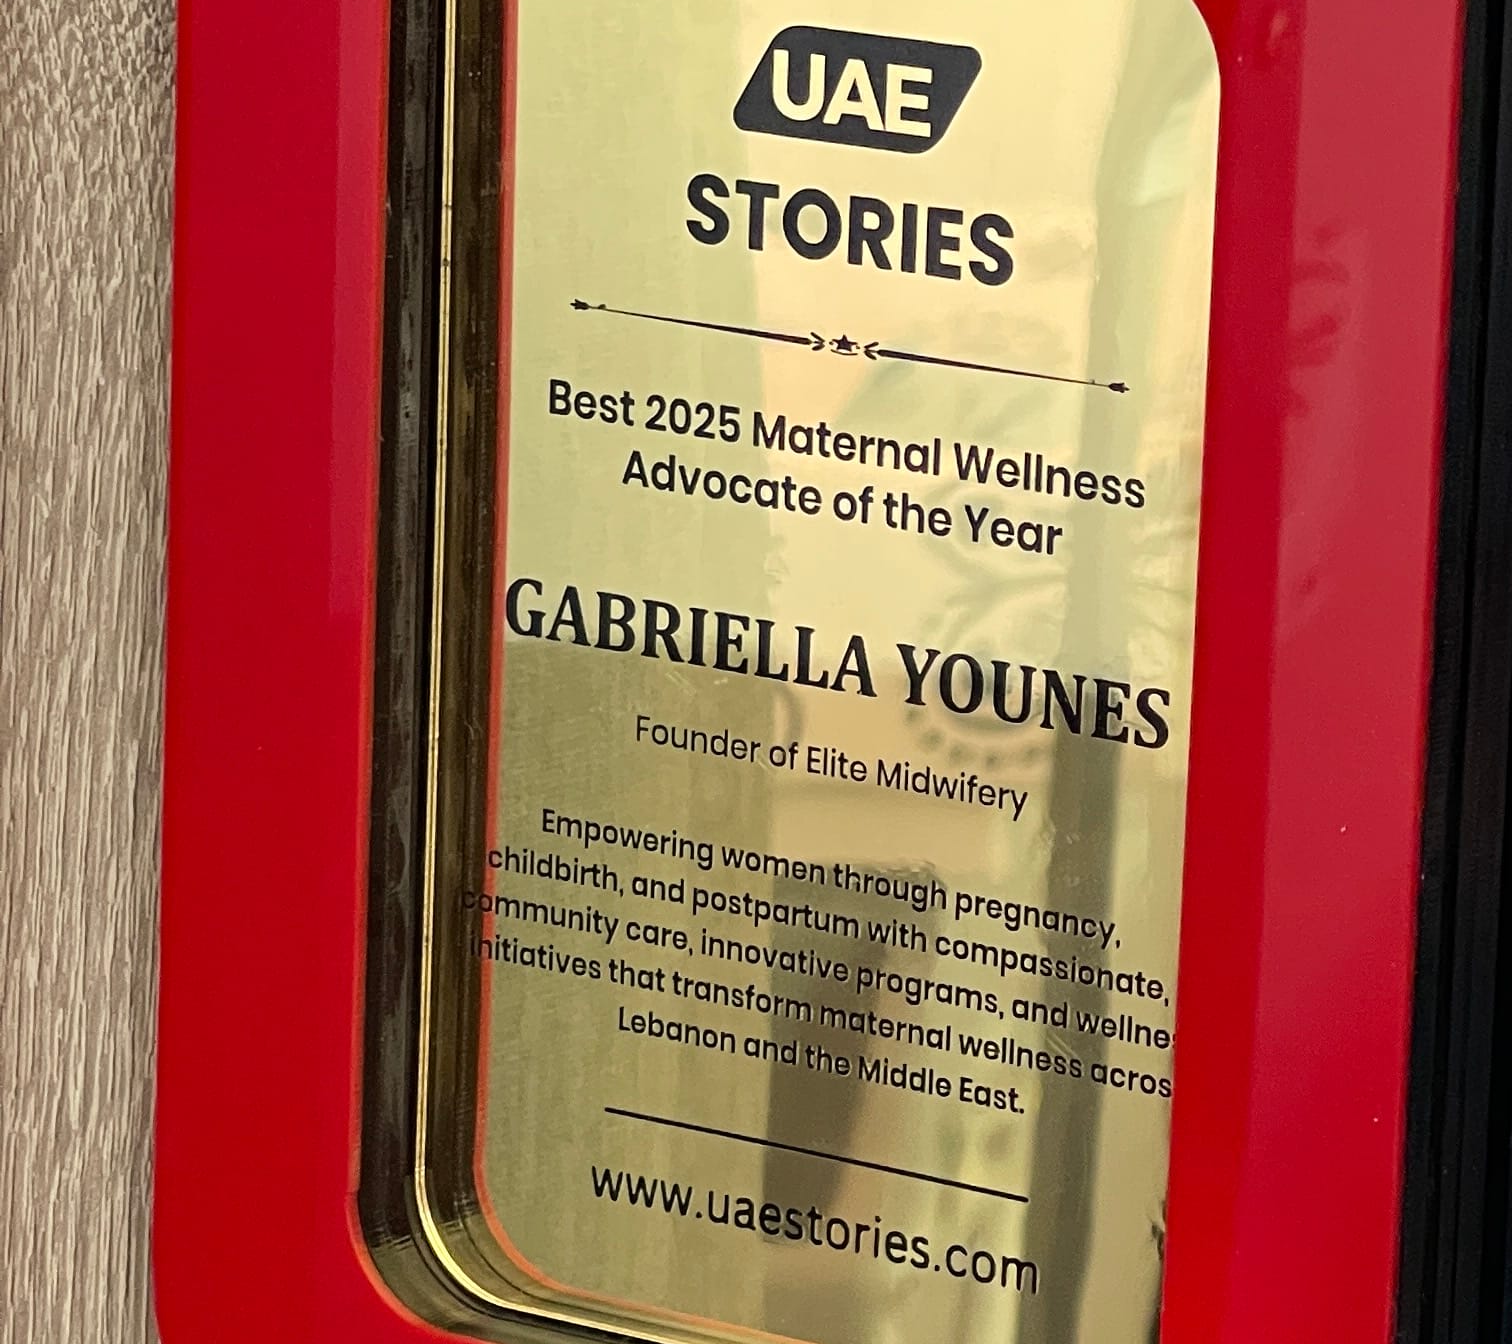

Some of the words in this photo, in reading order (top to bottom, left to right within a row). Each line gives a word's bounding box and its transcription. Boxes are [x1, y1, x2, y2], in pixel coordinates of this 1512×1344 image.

[772, 48, 932, 138] UAE
[686, 173, 1014, 286] STORIES
[548, 378, 635, 428] Best
[645, 393, 742, 444] 2025
[753, 411, 940, 476] Maternal
[953, 442, 1146, 509] Wellness
[622, 451, 822, 515] Advocate
[832, 485, 876, 523] of
[882, 488, 952, 535] the
[963, 504, 1064, 556] Year
[505, 577, 878, 698] GABRIELLA
[896, 642, 1172, 750] YOUNES
[635, 715, 760, 764] Founder
[768, 741, 801, 771] of
[806, 745, 868, 783] Elite
[876, 759, 1029, 822] Midwifery
[488, 847, 624, 897] childbirth,
[631, 876, 685, 904] and
[692, 886, 859, 939] postpartum
[867, 919, 927, 953] with
[935, 934, 1170, 1007] compassionate,
[542, 808, 713, 871] Empowering
[722, 845, 826, 886] women
[833, 863, 947, 912] through
[955, 890, 1122, 949] pregnancy,
[463, 889, 619, 945] community
[626, 920, 694, 956] care,
[701, 927, 850, 982] innovative
[856, 965, 1004, 1021] programs,
[1011, 998, 1068, 1029] and
[1076, 1009, 1175, 1050] wellne
[470, 929, 601, 980] initiatives
[608, 958, 665, 993] that
[672, 972, 812, 1023] transform
[820, 1004, 951, 1051] maternal
[958, 1032, 1083, 1079] wellness
[1090, 1060, 1172, 1098] acros
[618, 1007, 736, 1054] Lebanon
[744, 1036, 799, 1066] and
[805, 1045, 850, 1077] the
[858, 1055, 951, 1098] Middle
[959, 1077, 1025, 1115] East.
[591, 1164, 1038, 1295] www.uaestories.com
